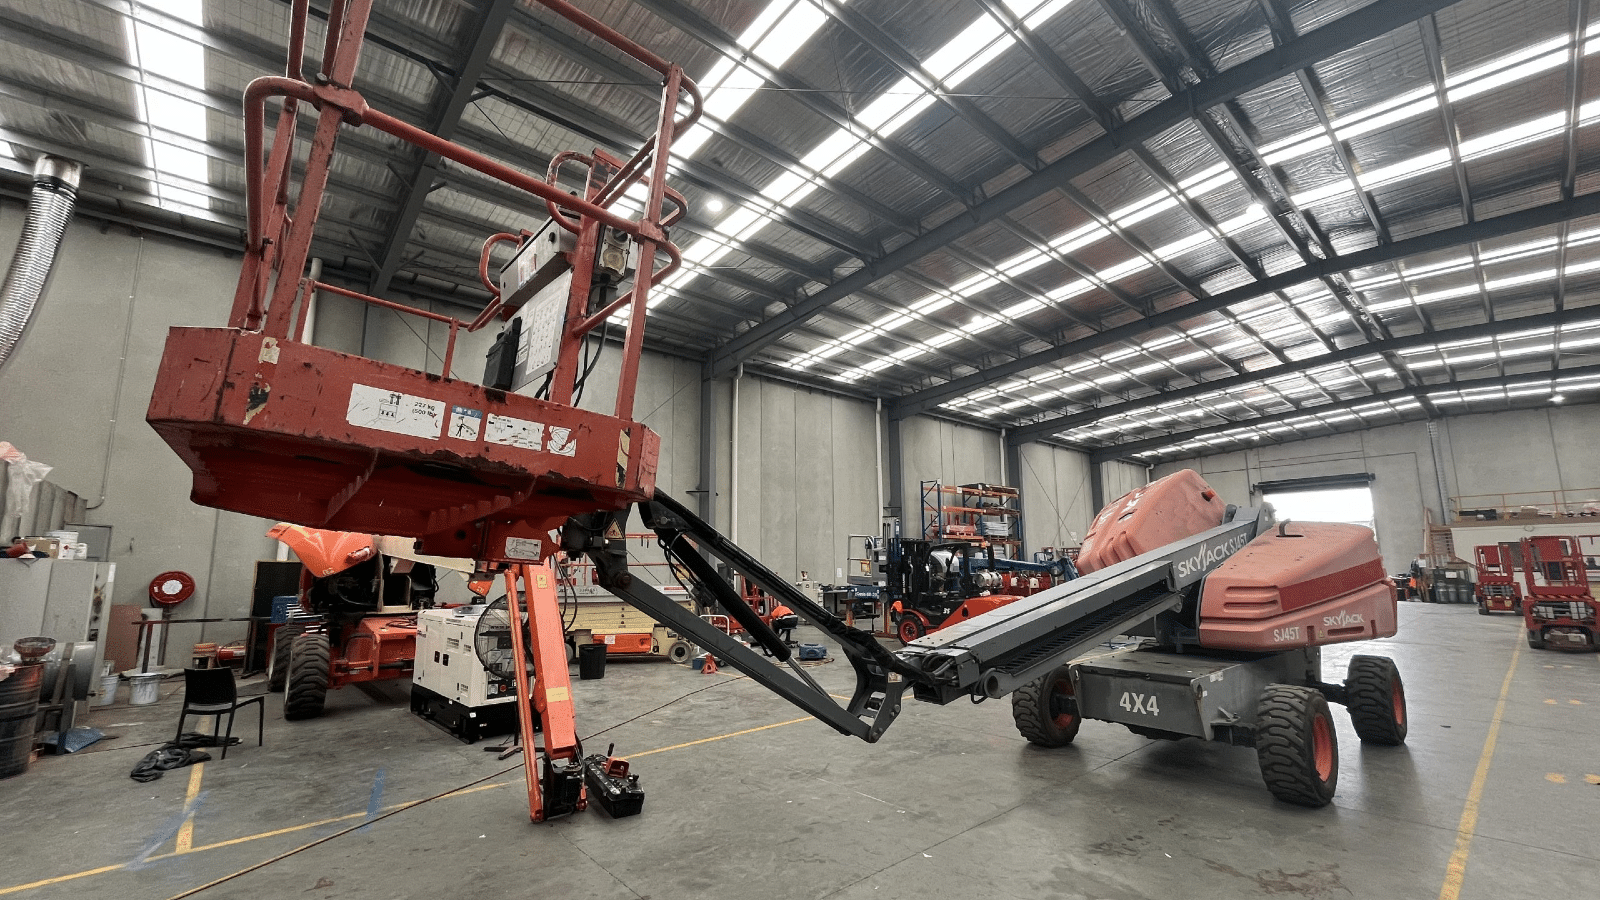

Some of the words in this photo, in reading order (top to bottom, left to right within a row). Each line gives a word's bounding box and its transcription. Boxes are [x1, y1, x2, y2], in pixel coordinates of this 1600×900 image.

[1178, 542, 1230, 578] SKYJACK
[1323, 609, 1364, 627] SKYJACK
[1273, 626, 1300, 642] SJ45T
[1119, 691, 1160, 716] 4X4
